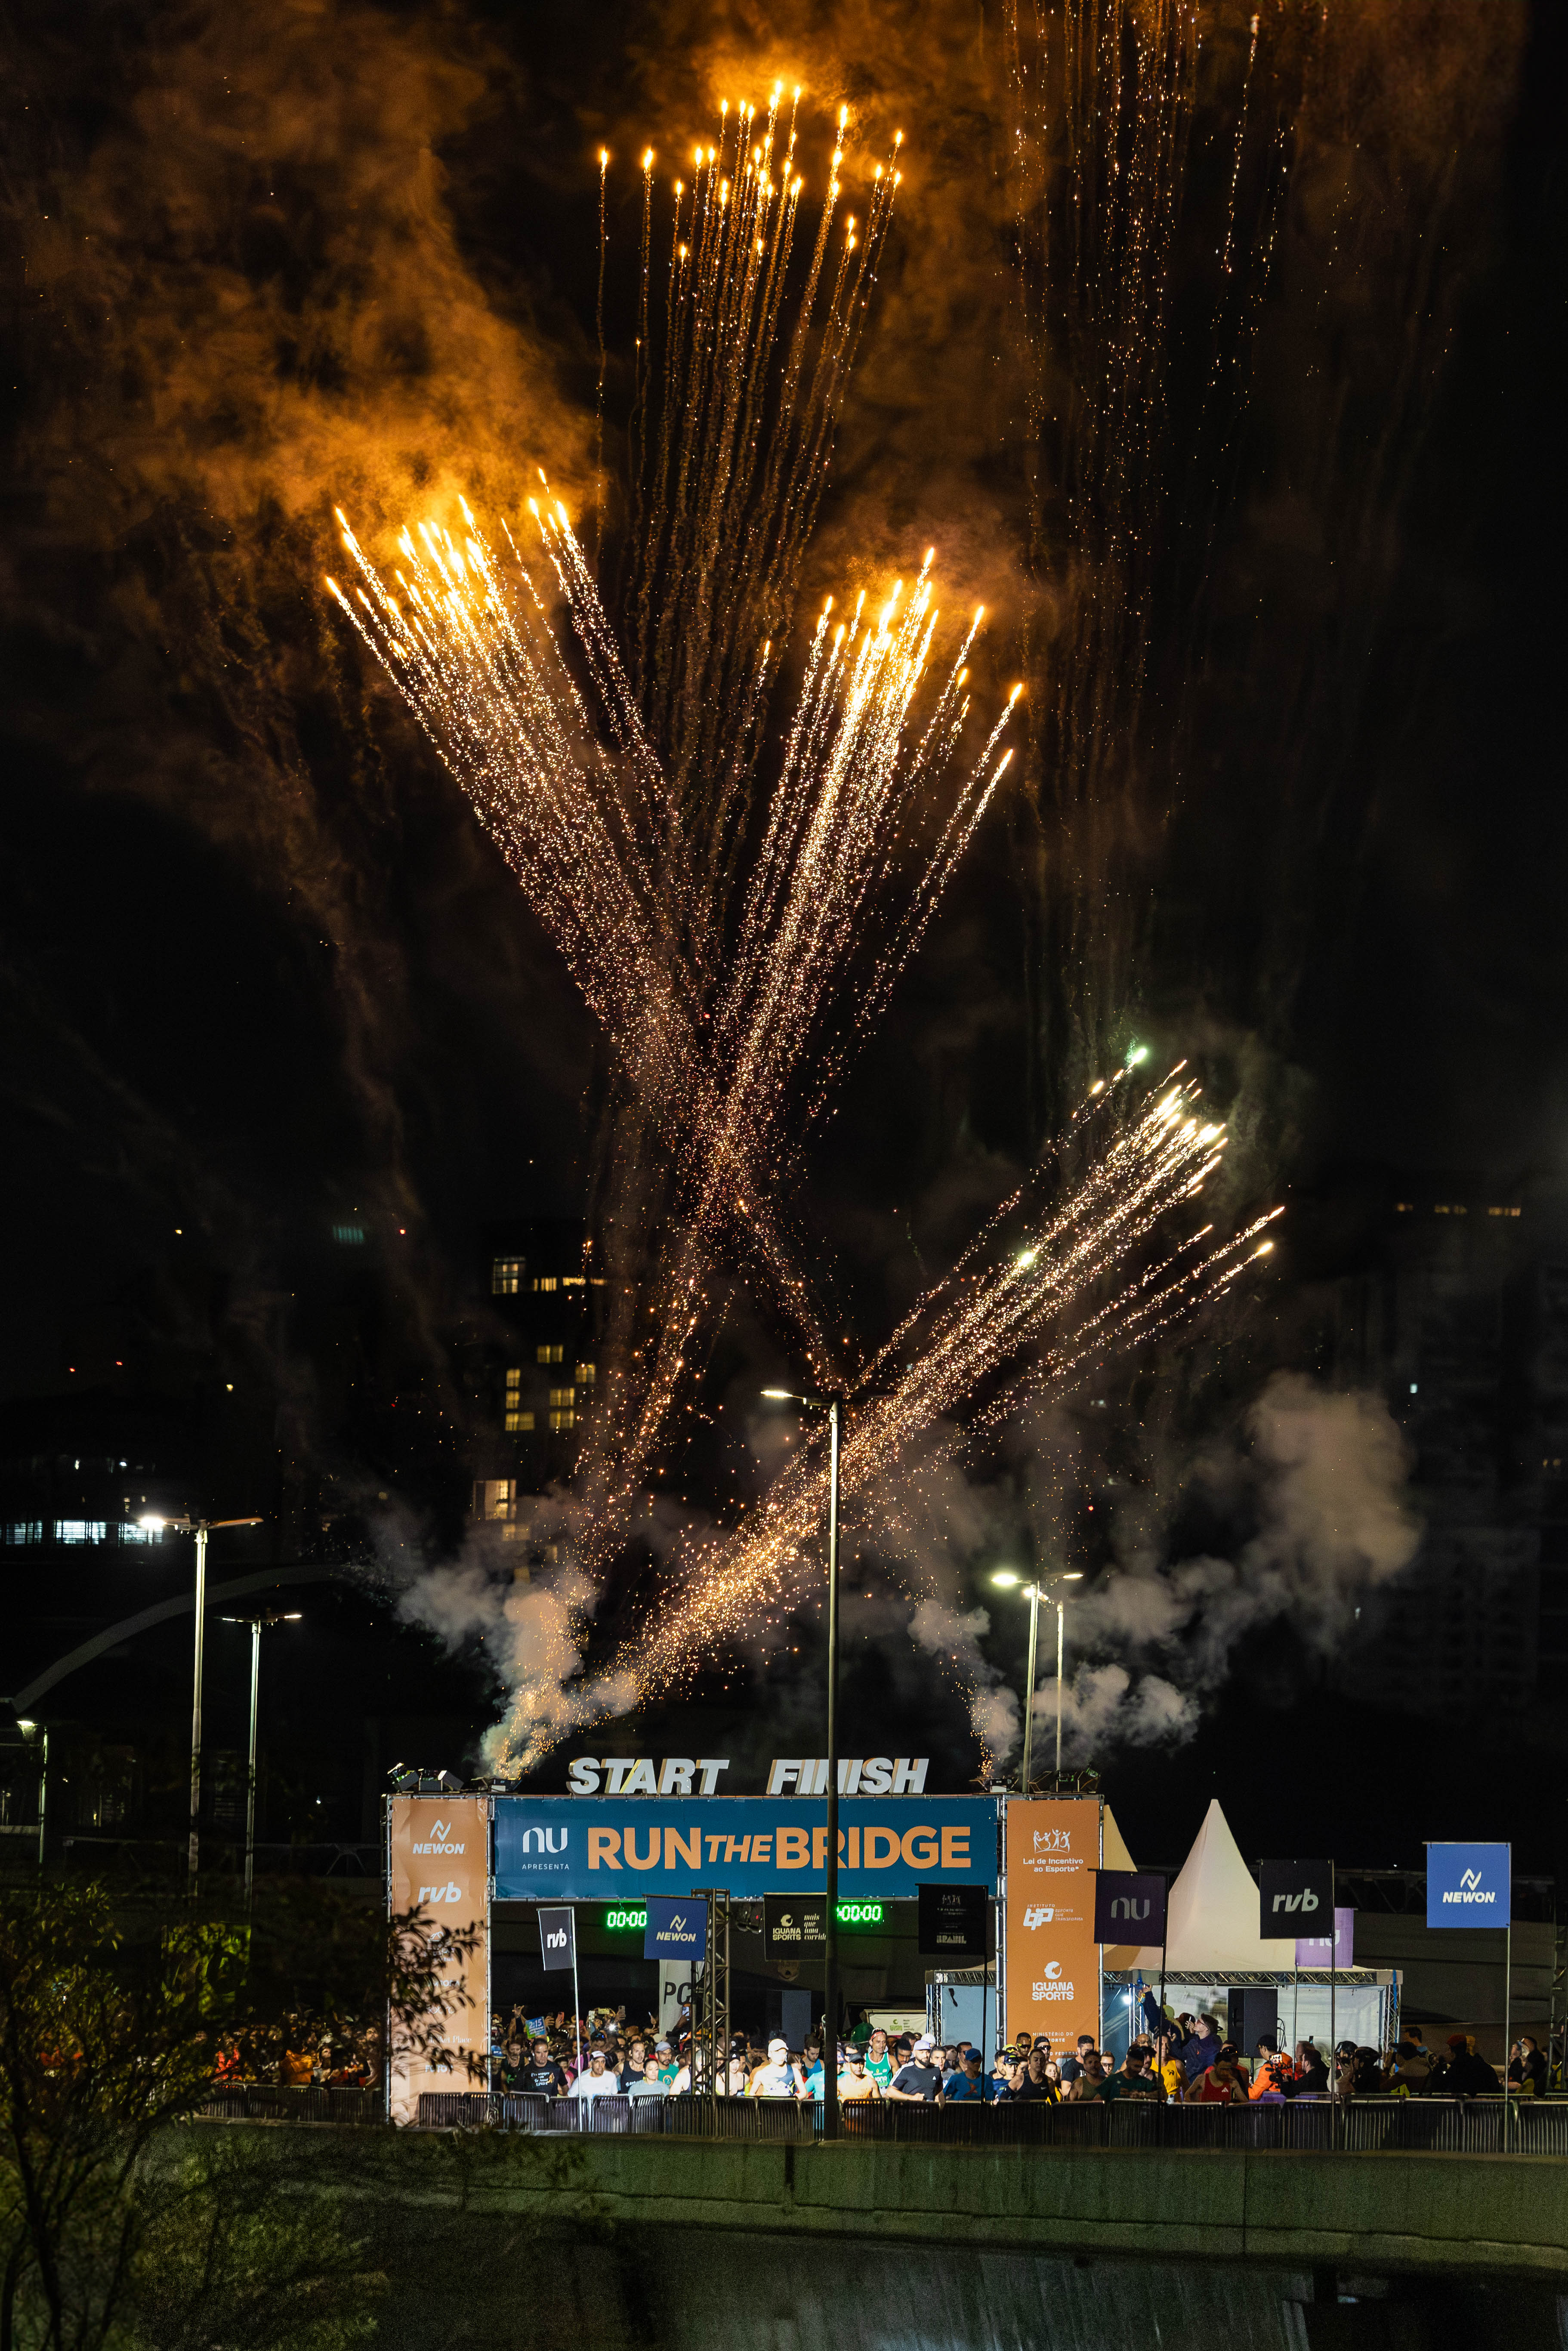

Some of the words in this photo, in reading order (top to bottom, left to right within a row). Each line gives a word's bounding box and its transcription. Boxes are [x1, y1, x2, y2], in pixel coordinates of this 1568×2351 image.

[566, 1757, 729, 1794] START
[766, 1757, 929, 1794] FINISH
[413, 1843, 465, 1854] NEWON
[588, 1827, 701, 1870] RUN
[705, 1835, 772, 1862] THE
[776, 1826, 971, 1869] BRIDGE
[418, 1882, 461, 1903] rvb
[1272, 1888, 1318, 1912] rvb
[1442, 1892, 1495, 1903] NEWON
[547, 1928, 567, 1948] rvb
[656, 1932, 696, 1942] NEWON
[1033, 1982, 1074, 1991] IGUANA
[1032, 1991, 1074, 2001] SPORTS
